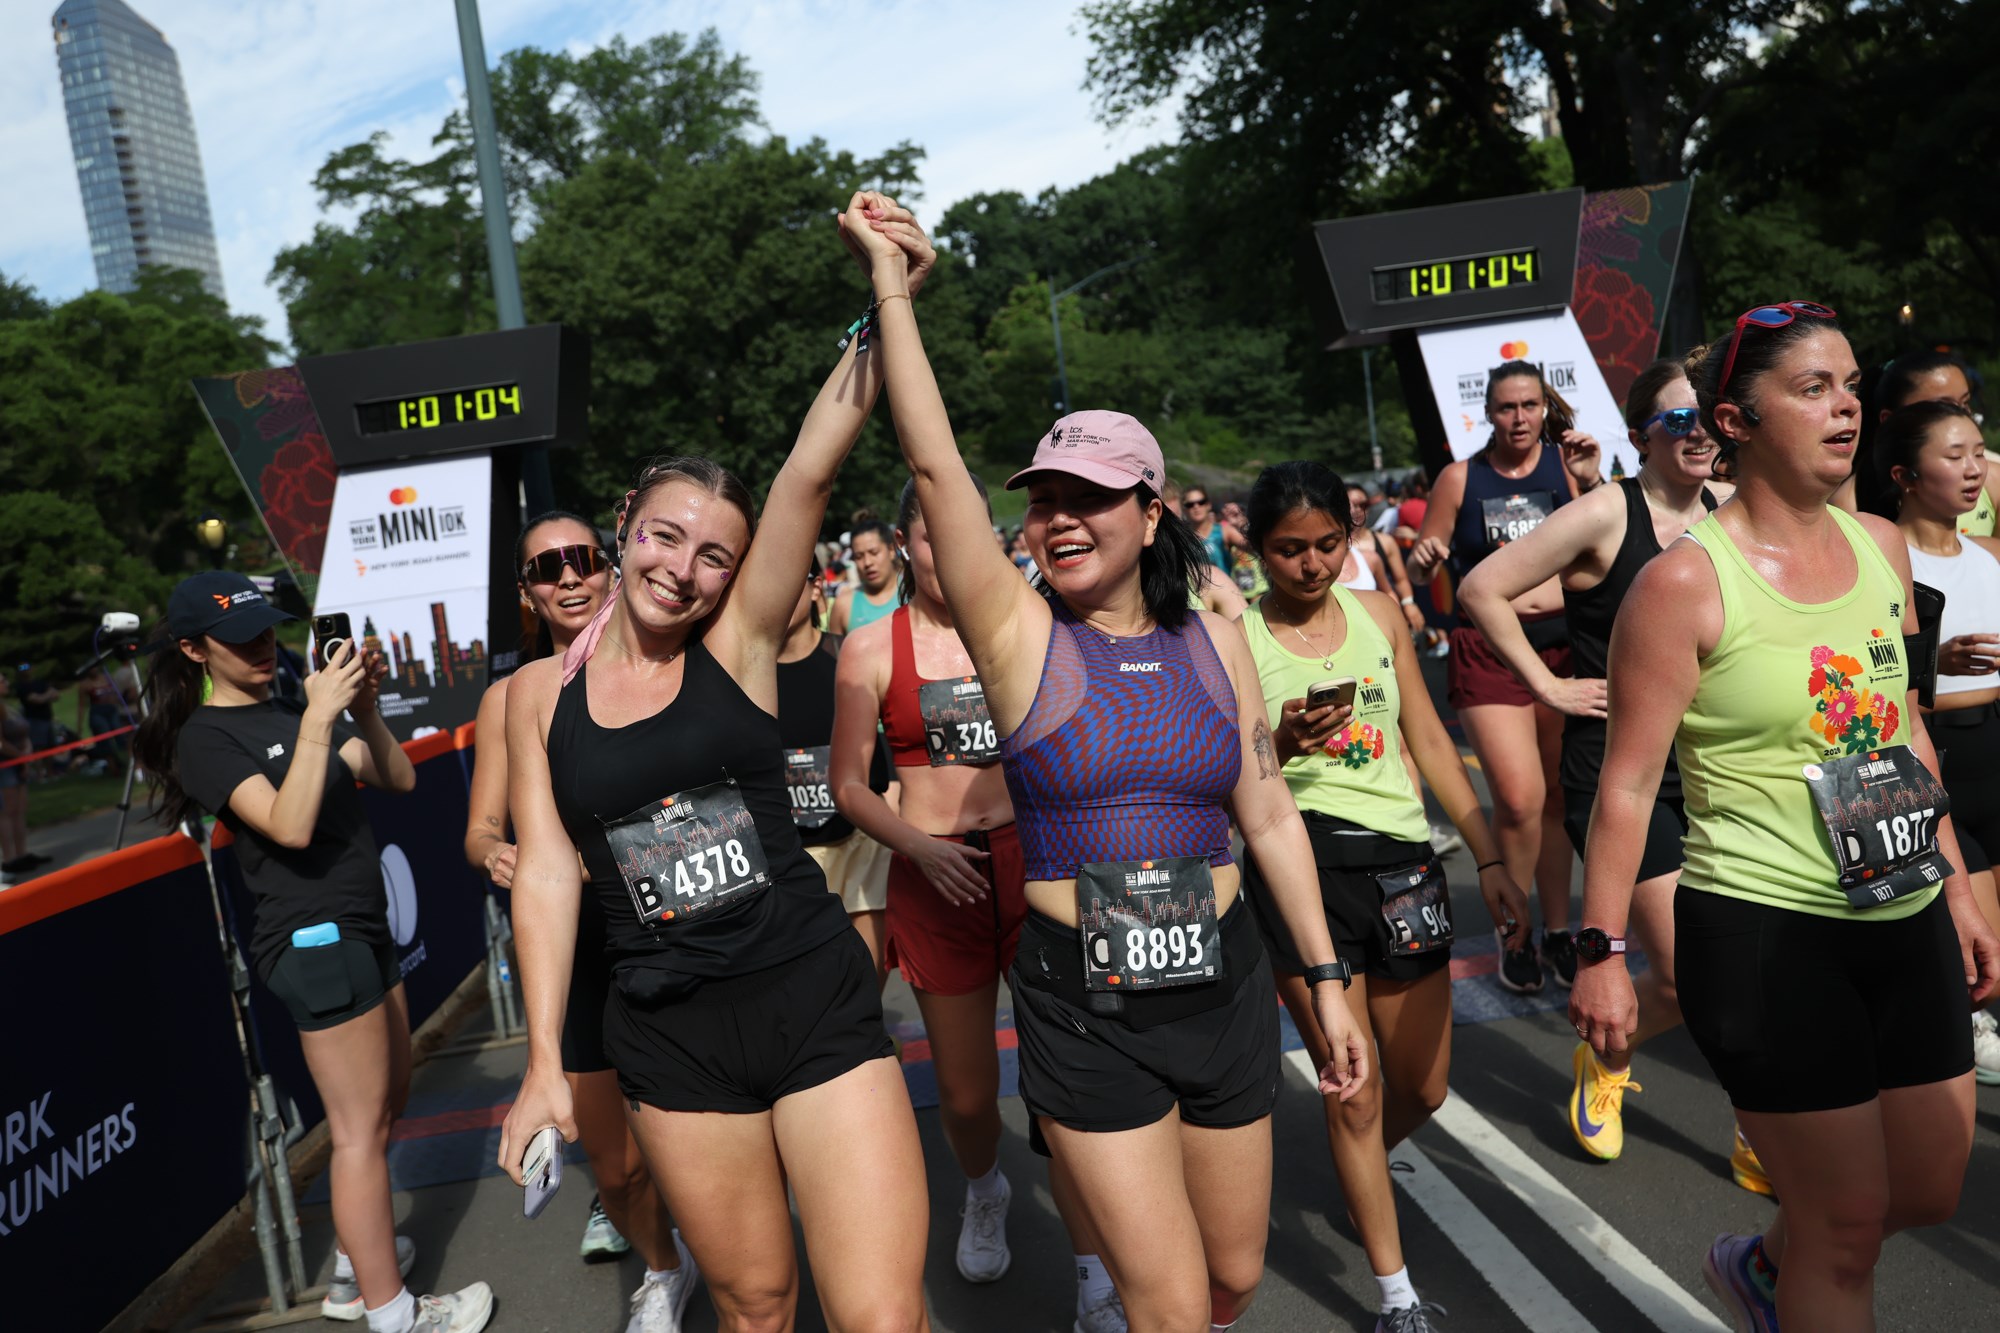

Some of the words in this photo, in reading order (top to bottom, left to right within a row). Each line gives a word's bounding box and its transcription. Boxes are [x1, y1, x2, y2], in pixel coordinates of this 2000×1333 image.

[1458, 380, 1484, 390] NEW
[1549, 367, 1576, 389] 10K
[1460, 391, 1485, 400] YORK
[1069, 426, 1083, 434] tcs
[350, 524, 376, 535] NEW
[379, 506, 437, 549] MINI
[439, 511, 466, 533] 10K
[352, 535, 376, 545] YORK
[1868, 643, 1899, 668] MINI
[1360, 687, 1386, 706] MINI
[929, 731, 947, 753] D
[956, 720, 998, 752] 326
[1867, 760, 1889, 778] MINI
[787, 784, 835, 808] 1036
[661, 803, 685, 822] MINI
[1876, 808, 1934, 861] 1877
[1838, 830, 1867, 868] D
[674, 839, 751, 898] 4378
[1137, 869, 1159, 886] MINI
[1160, 872, 1170, 881] 10K
[1921, 866, 1941, 882] 1877
[631, 875, 664, 916] B
[1872, 885, 1895, 901] 1877
[1088, 931, 1113, 970] C
[1126, 924, 1203, 971] 8893
[0, 1090, 55, 1166] RK
